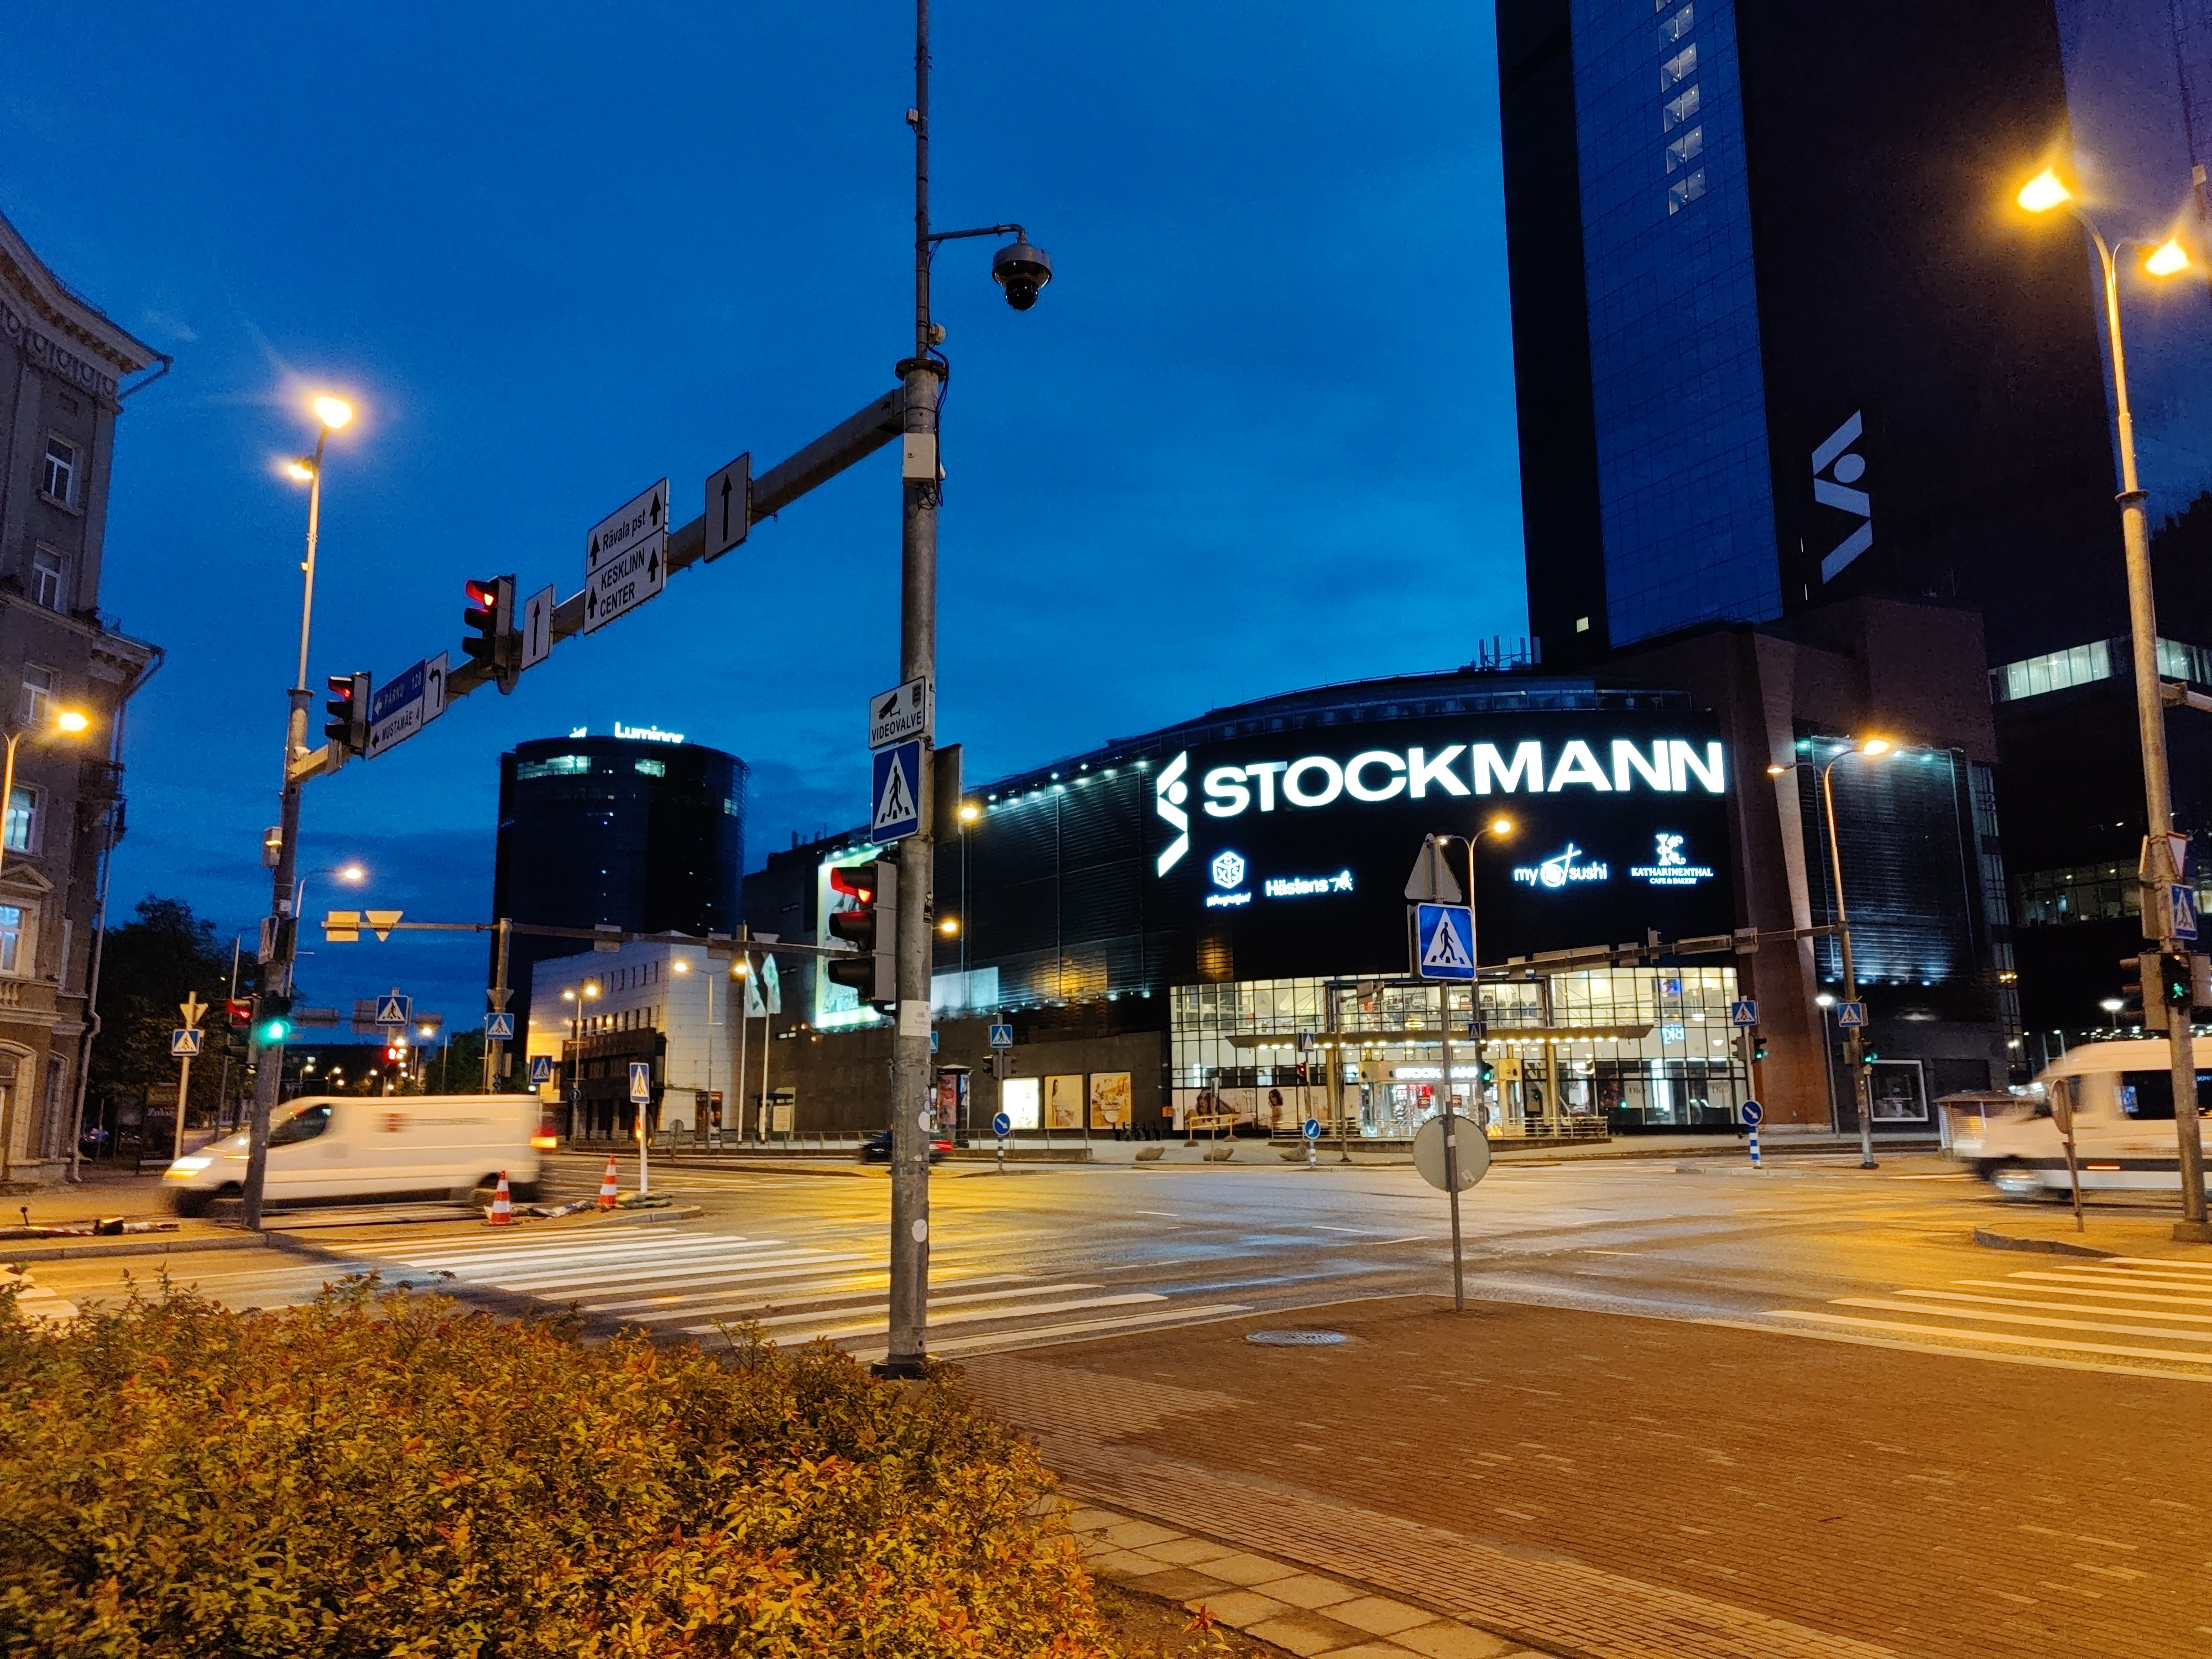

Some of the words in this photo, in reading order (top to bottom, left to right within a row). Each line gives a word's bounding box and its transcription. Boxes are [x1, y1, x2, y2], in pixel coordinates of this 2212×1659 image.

[602, 521, 630, 552] Rävala
[632, 509, 646, 538] pst
[601, 547, 645, 592] KESKLINN
[599, 581, 635, 618] CENTER
[382, 710, 413, 741] MUSTAMÄE
[614, 721, 685, 744] Luminor
[872, 711, 922, 742] VIDEOVALVE
[1203, 740, 1725, 817] STOCKMANN
[1265, 878, 1329, 896] Hästens
[1514, 867, 1539, 886] my
[1568, 861, 1608, 880] sushi
[1630, 867, 1714, 878] KATHARINENTHAL
